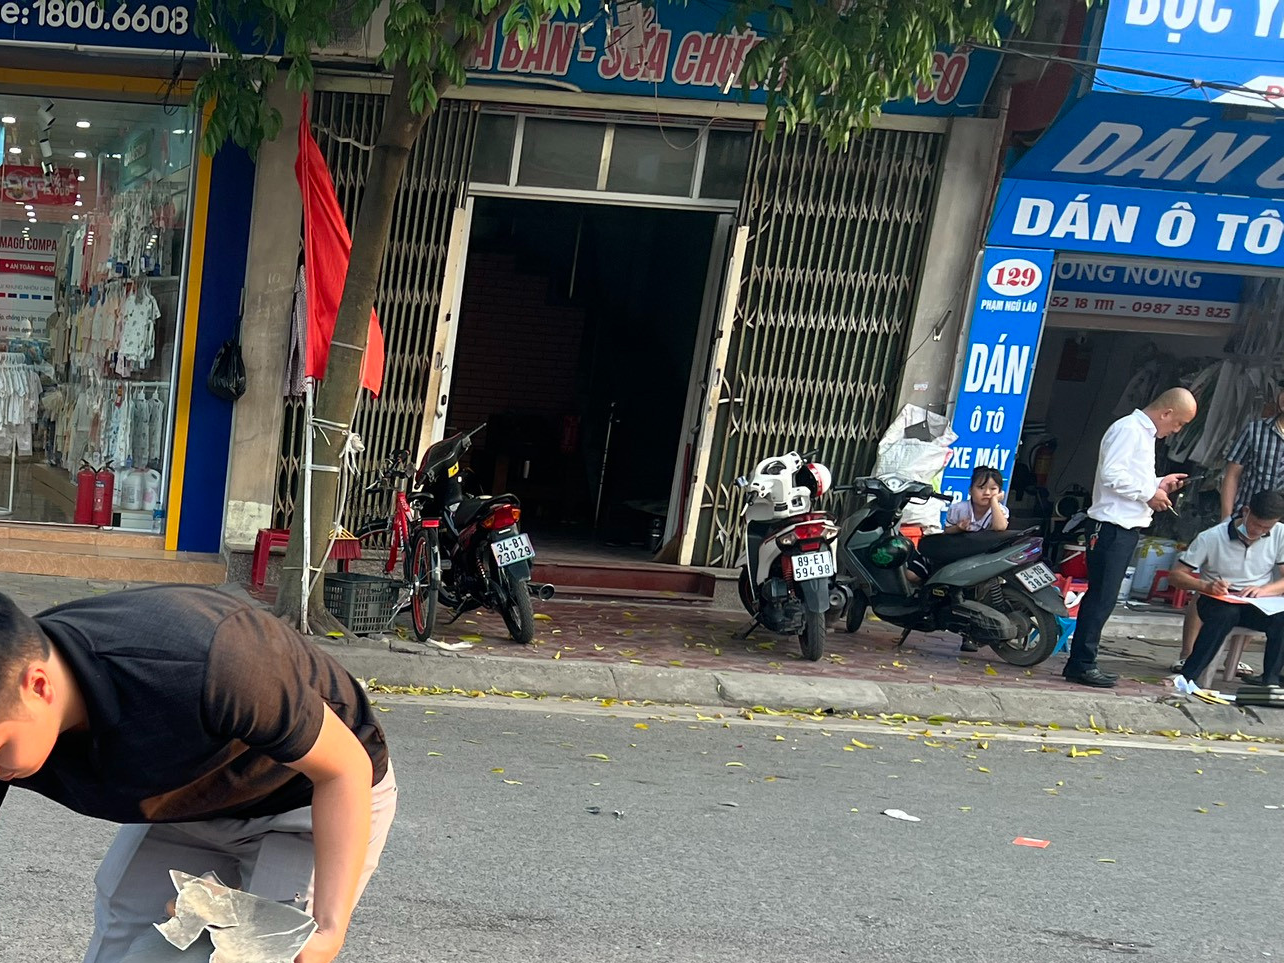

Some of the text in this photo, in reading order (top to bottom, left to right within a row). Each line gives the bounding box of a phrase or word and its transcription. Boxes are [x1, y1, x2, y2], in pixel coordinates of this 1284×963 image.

[1051, 116, 1272, 184] DÁN
[1011, 193, 1284, 255] DÁN Ô TÔ
[992, 266, 1036, 287] 129
[980, 297, 1038, 313] PHẠM NGŨ LÃO
[1075, 298, 1088, 309] 18
[1132, 301, 1171, 314] 0987
[1175, 304, 1200, 316] 353
[1205, 306, 1231, 319] 825
[964, 333, 1030, 395] DÁN
[970, 405, 1005, 434] Ô TÔ
[949, 443, 1011, 471] XE MÁY
[496, 536, 525, 553] 34-B1
[797, 553, 825, 567] 89-E1
